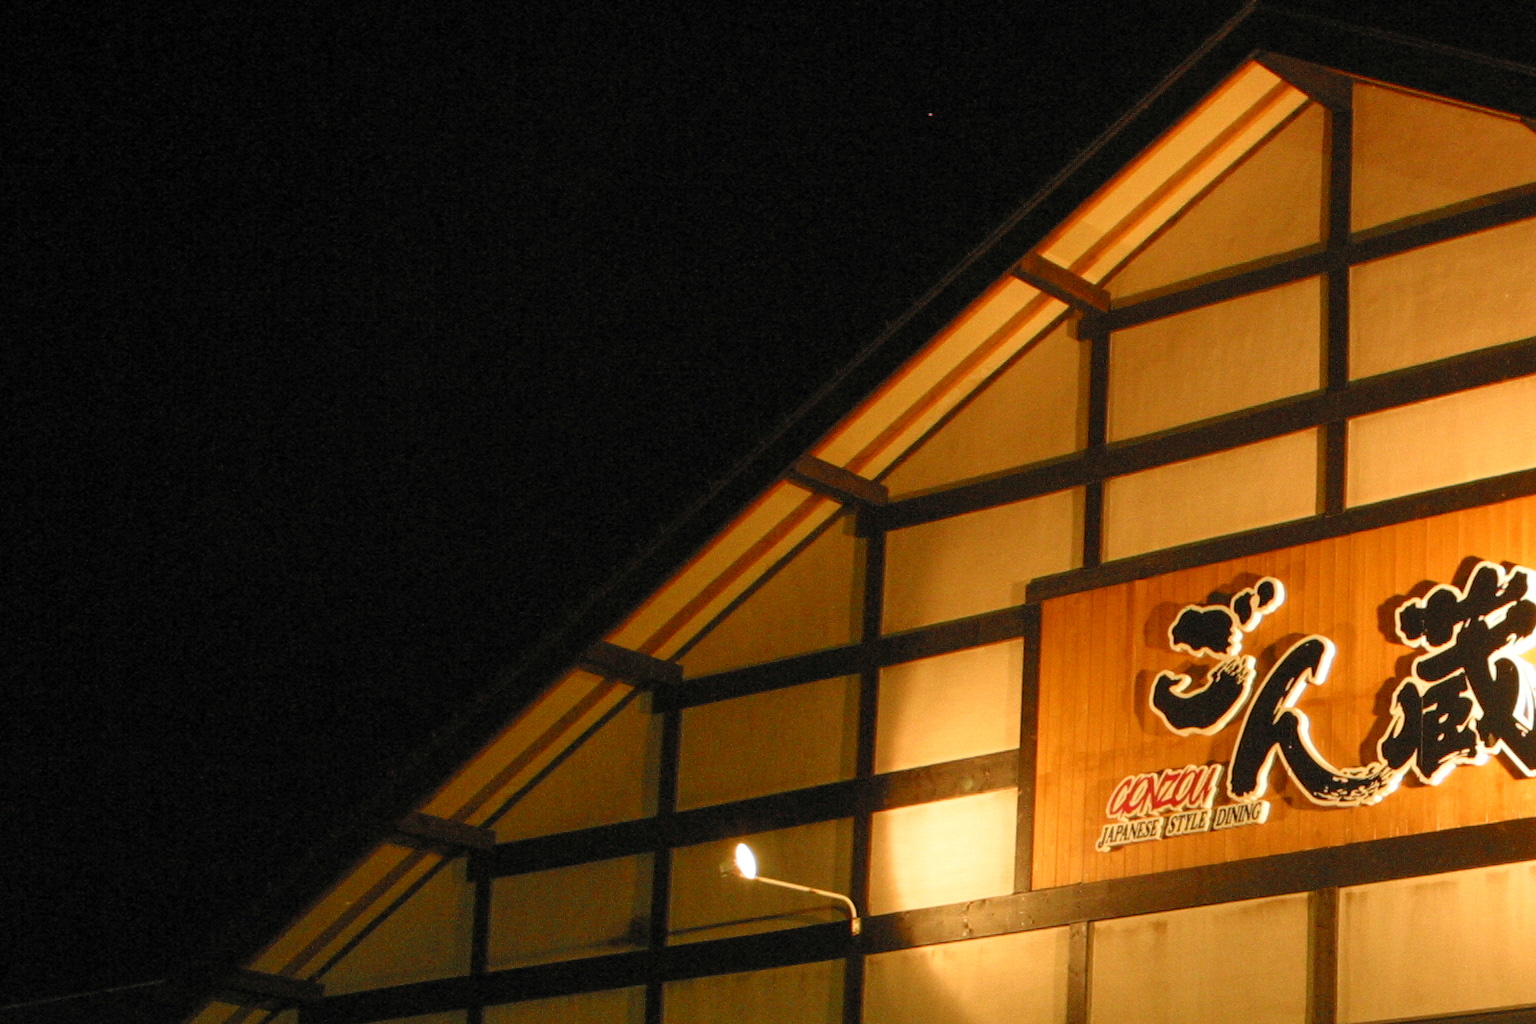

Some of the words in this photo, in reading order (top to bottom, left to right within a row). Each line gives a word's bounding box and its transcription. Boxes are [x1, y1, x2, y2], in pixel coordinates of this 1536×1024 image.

[1109, 766, 1219, 816] GONZOU
[1097, 818, 1160, 848] JAPANESE
[1167, 810, 1208, 835] STYLE
[1215, 801, 1263, 827] DINING
